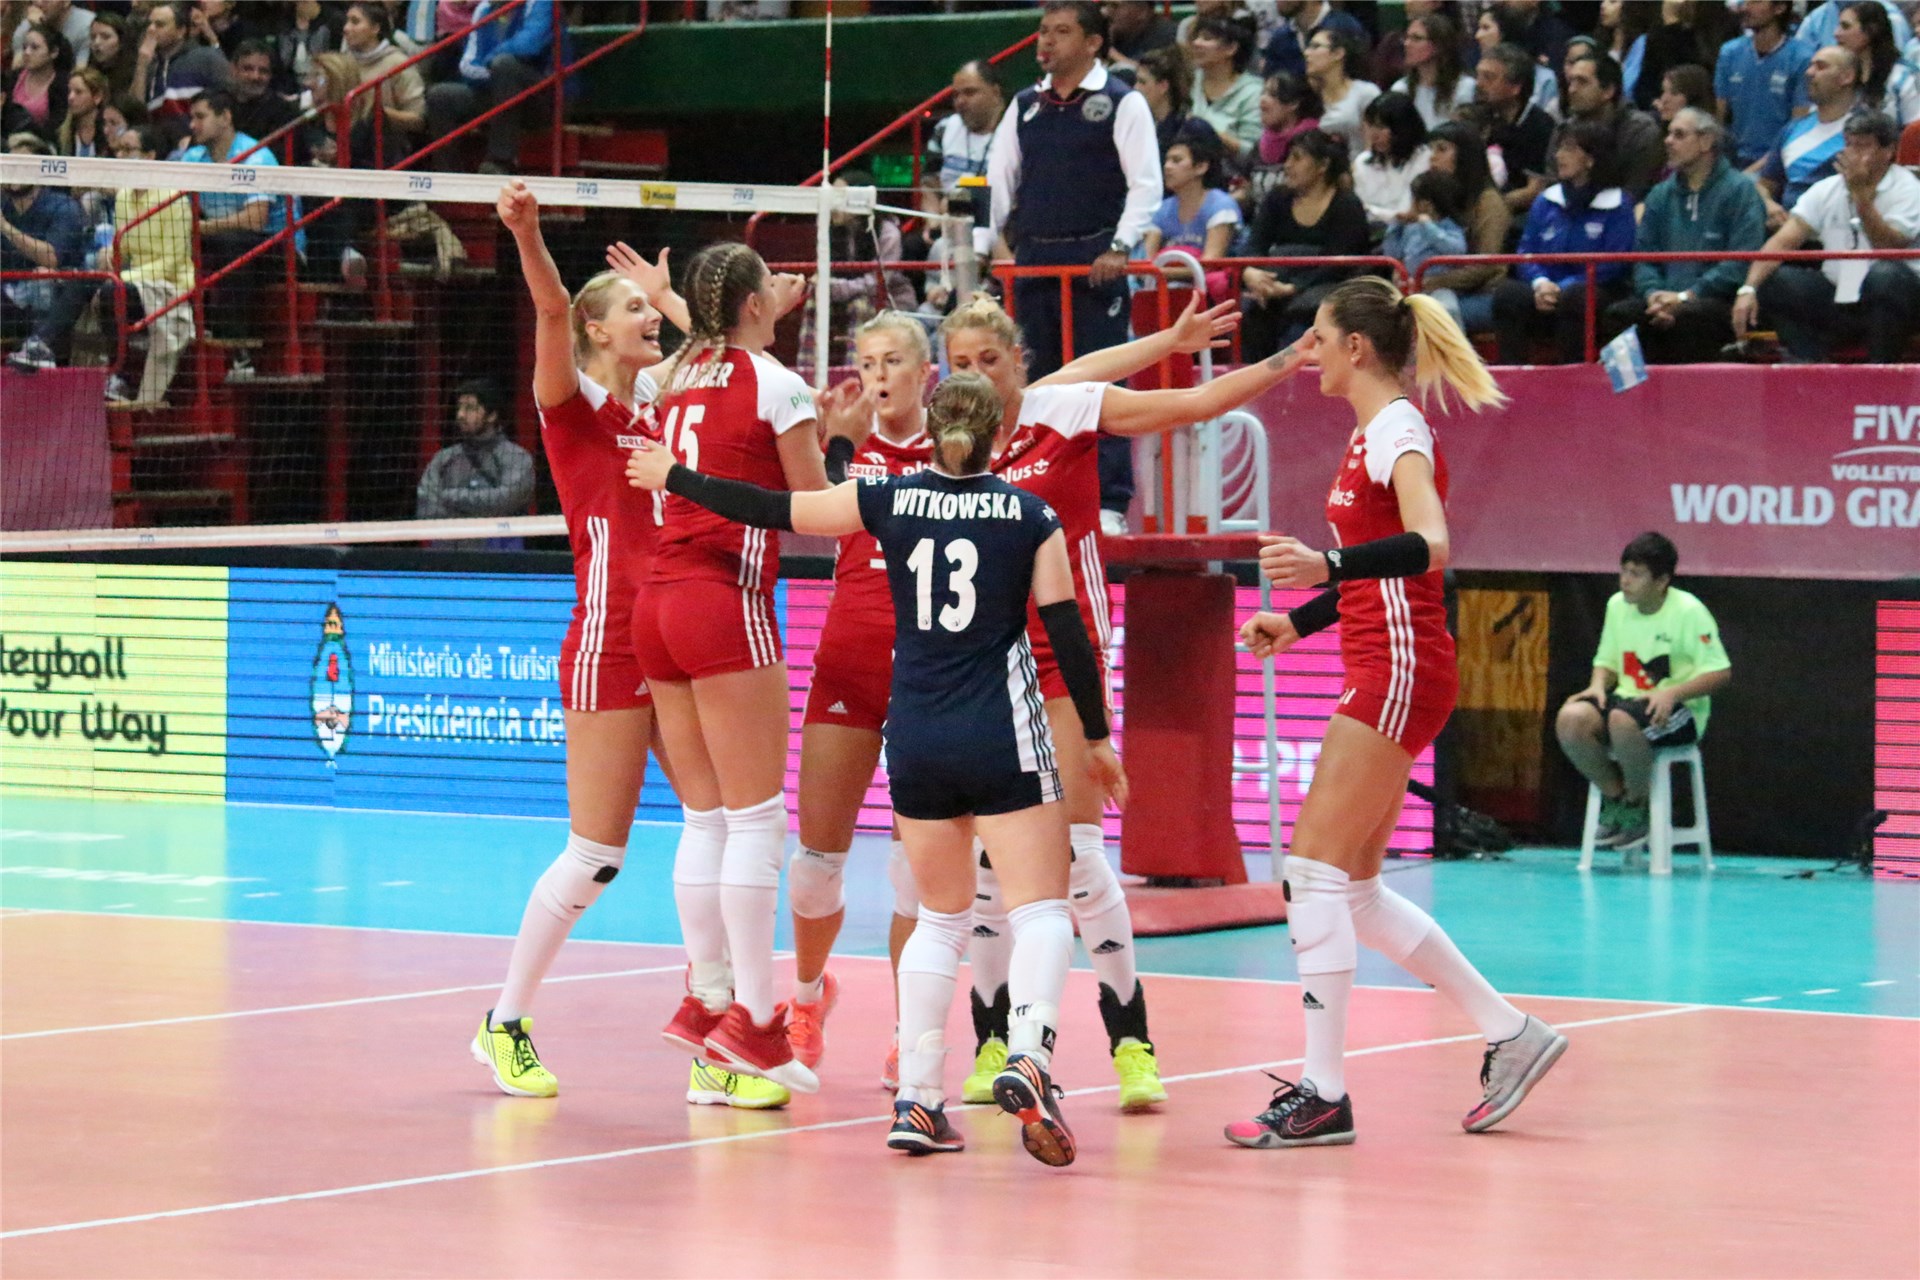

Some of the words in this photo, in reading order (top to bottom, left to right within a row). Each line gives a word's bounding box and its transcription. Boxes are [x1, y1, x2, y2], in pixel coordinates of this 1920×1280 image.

[1853, 405, 1920, 440] FIV
[848, 465, 883, 476] ORLEN
[892, 488, 1022, 521] WITKOWSKA
[1671, 484, 1835, 526] WORLD
[907, 538, 979, 632] 13
[369, 642, 463, 679] Ministerio
[467, 643, 494, 680] de
[81, 700, 166, 757] Way
[368, 694, 522, 745] Presidencia
[529, 697, 565, 746] de
